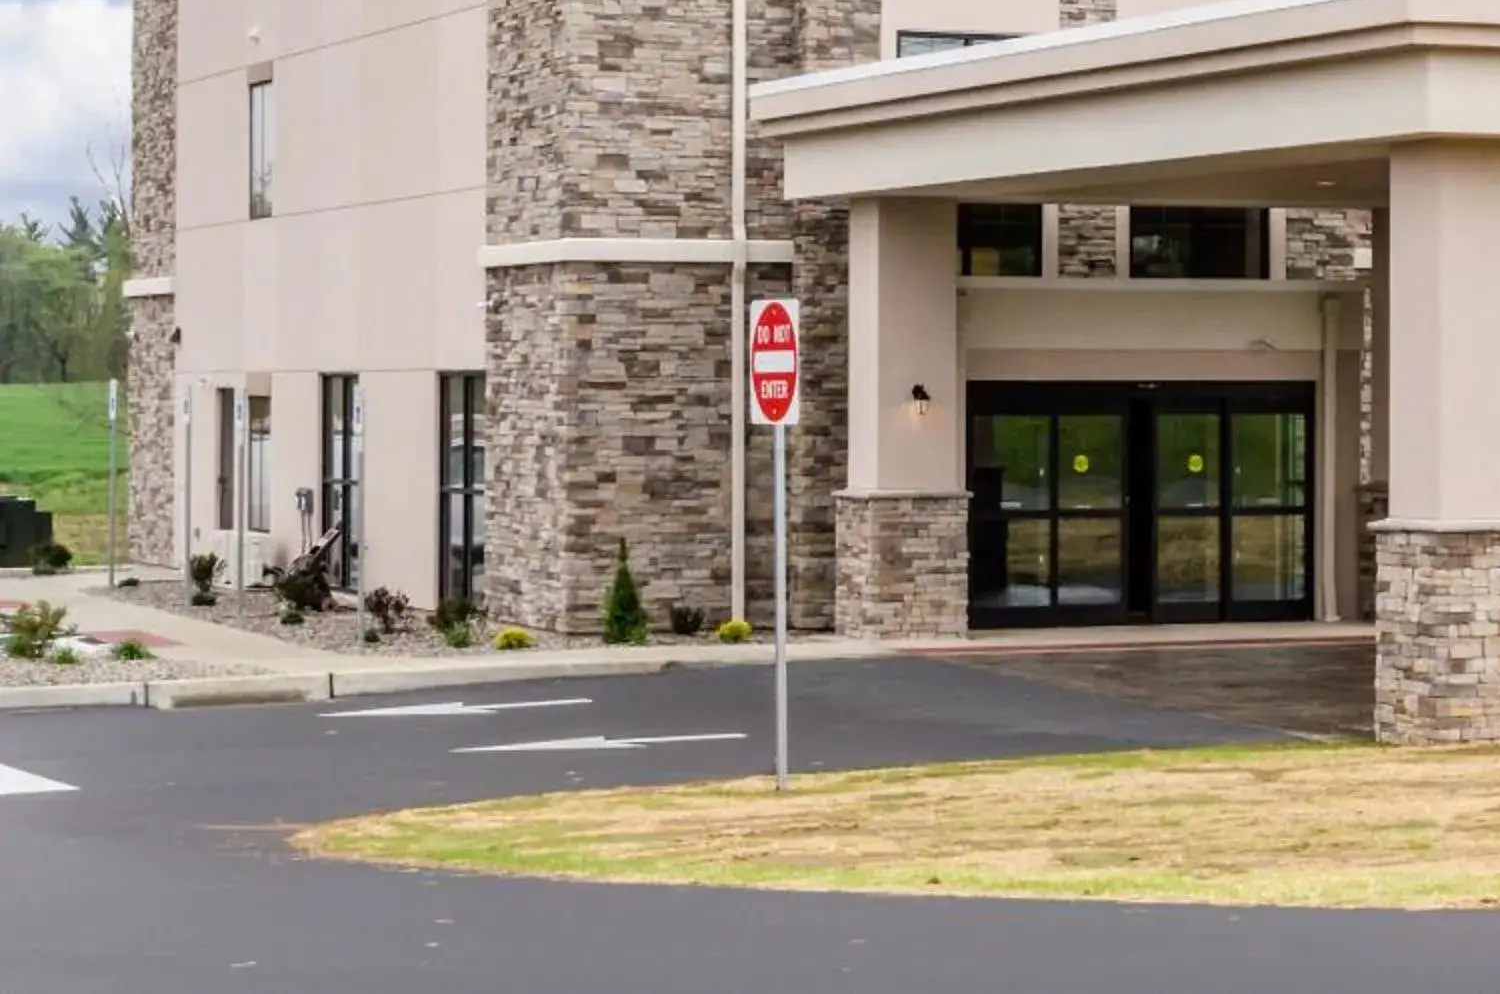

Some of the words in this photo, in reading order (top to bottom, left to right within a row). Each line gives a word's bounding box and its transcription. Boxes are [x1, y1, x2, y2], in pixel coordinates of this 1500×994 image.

[757, 325, 770, 343] DO
[773, 324, 791, 343] NOT
[761, 380, 788, 399] ENTER
